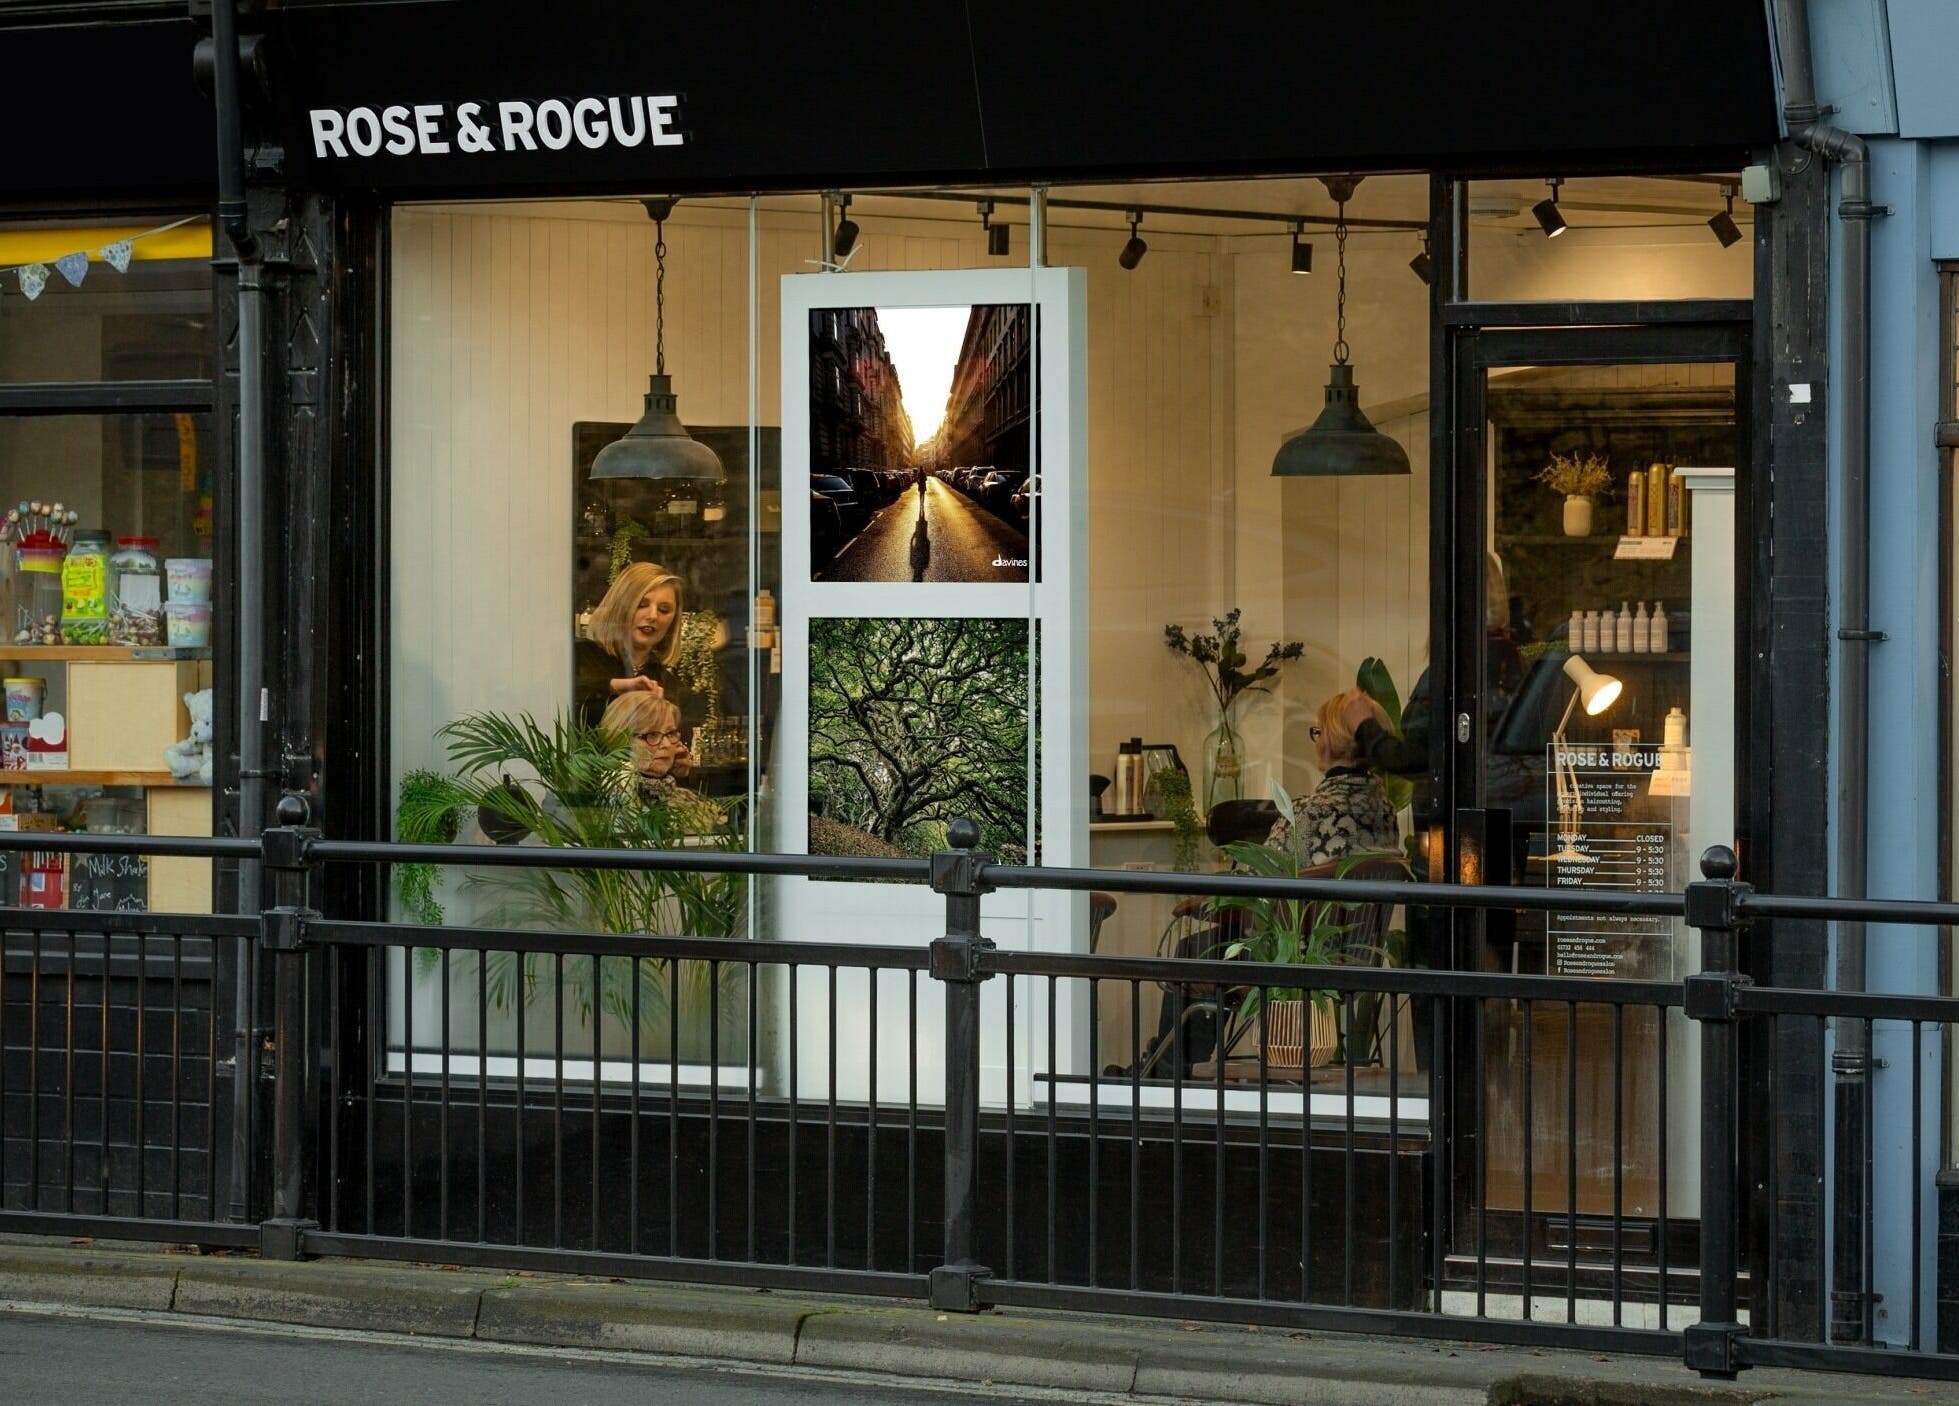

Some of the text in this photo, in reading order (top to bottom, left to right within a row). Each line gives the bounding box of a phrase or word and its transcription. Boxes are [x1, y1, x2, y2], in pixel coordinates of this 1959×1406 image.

[310, 95, 684, 158] ROSE & ROGUE
[992, 553, 1028, 567] davines
[1557, 752, 1662, 767] ROSE & ROGUE
[1557, 833, 1664, 843] MONDAY CLOSED
[1557, 844, 1590, 852] TUESDAY
[1636, 845, 1642, 853] 9
[1647, 845, 1664, 854] 5:30
[1557, 855, 1601, 864] WEDNESDAY
[1636, 856, 1642, 865] 9
[1647, 856, 1664, 865] 5:30
[88, 854, 115, 879] Milk
[1557, 866, 1595, 874] THURSDAY
[1636, 867, 1642, 876] 9
[1647, 867, 1664, 876] 5:30
[1557, 877, 1583, 885] FRIDAY
[1636, 878, 1642, 887] 9
[1647, 878, 1664, 887] 5:30
